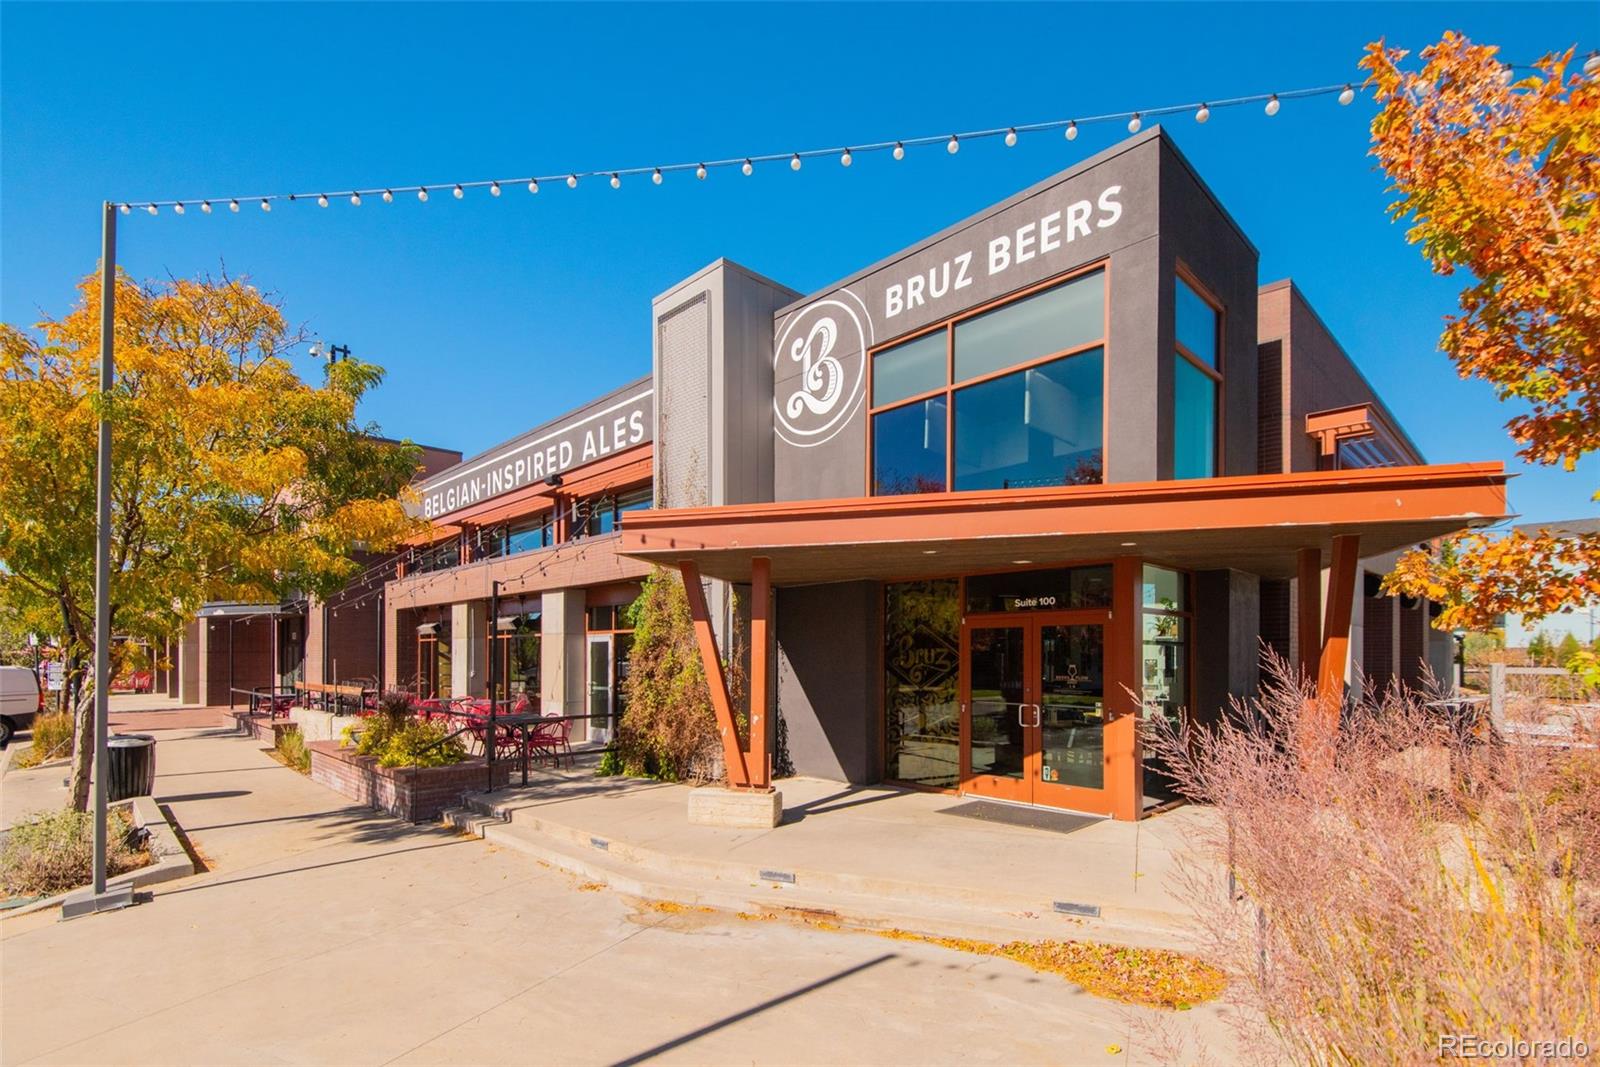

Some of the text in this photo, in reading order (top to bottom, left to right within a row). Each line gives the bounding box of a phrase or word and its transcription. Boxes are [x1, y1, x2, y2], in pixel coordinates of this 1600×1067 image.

[885, 185, 1123, 319] BRUZ BEERS
[424, 409, 644, 518] BELGIAN-INSPIRED ALES
[1014, 596, 1056, 608] Suite 100
